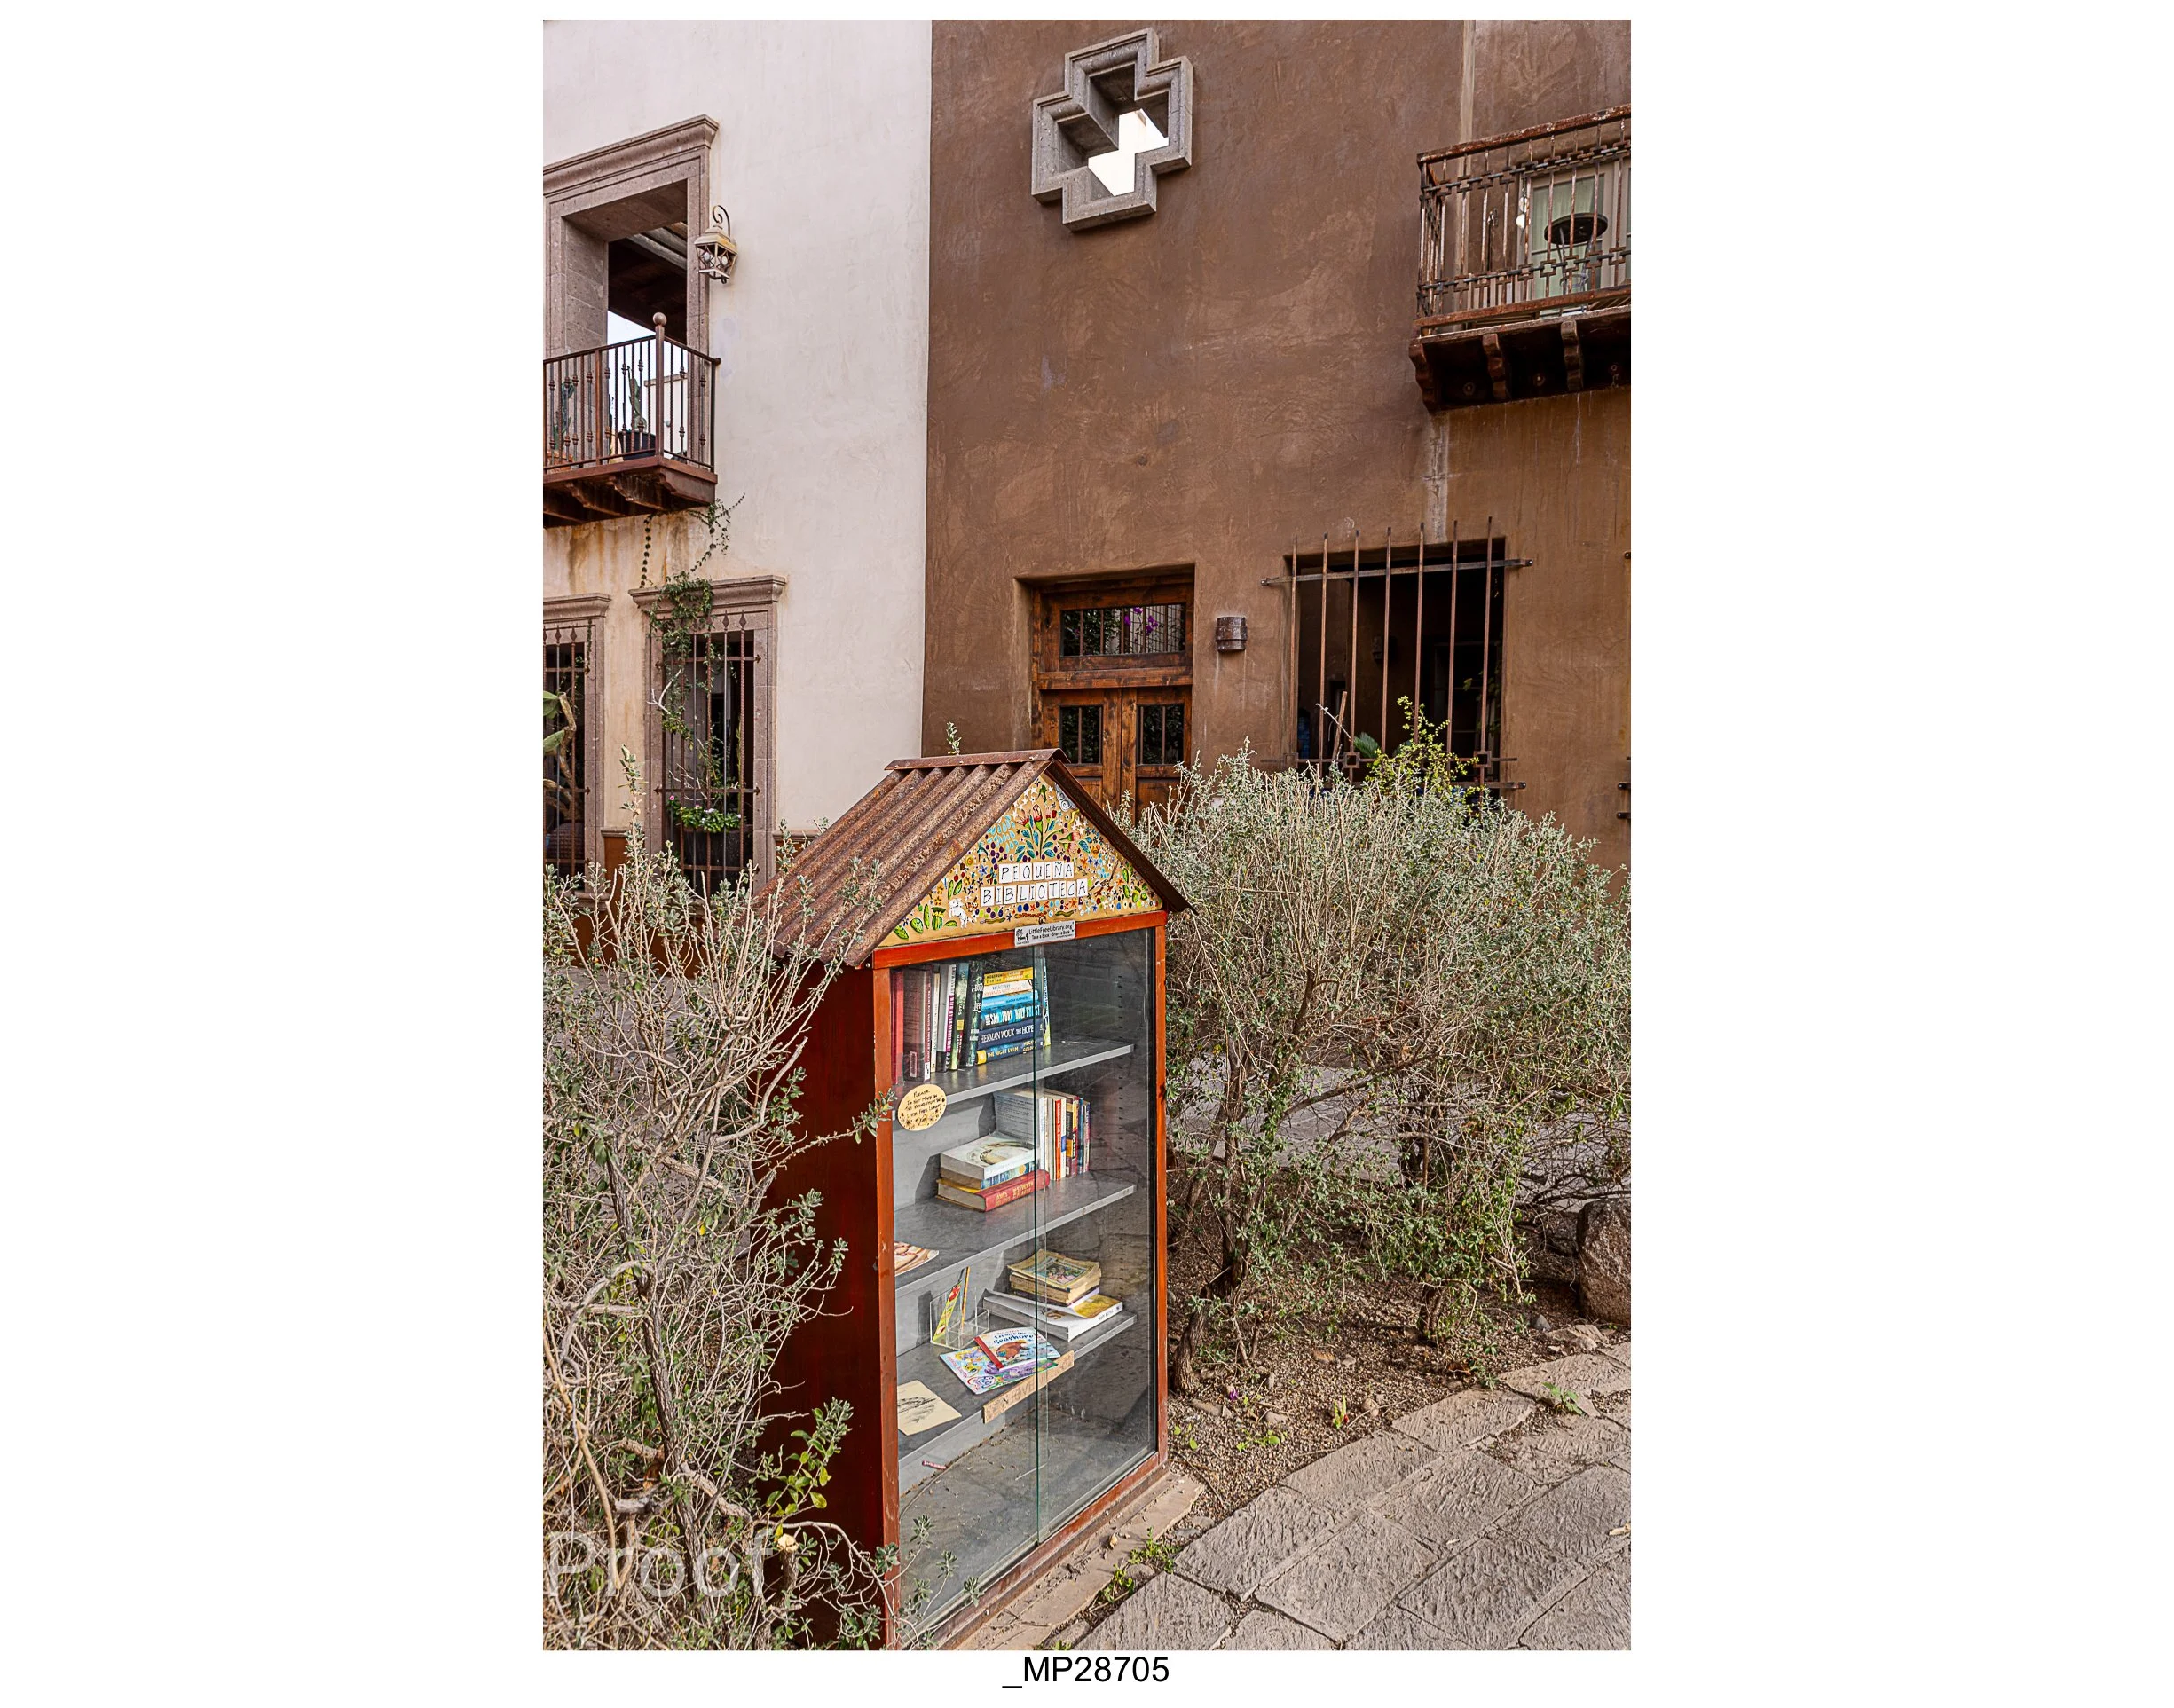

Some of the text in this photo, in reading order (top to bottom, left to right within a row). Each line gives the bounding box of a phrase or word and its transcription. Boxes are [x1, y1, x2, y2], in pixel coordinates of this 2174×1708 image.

[1001, 861, 1073, 880] PEQUEÑA
[982, 881, 1086, 905] BIBLIOTECA
[1029, 924, 1073, 935] LittleFreeLibrary.org
[1026, 1004, 1040, 1018] GHST
[980, 1030, 1001, 1043] HERMAN
[1000, 1027, 1015, 1039] WOUK
[1021, 1024, 1034, 1035] HOPE
